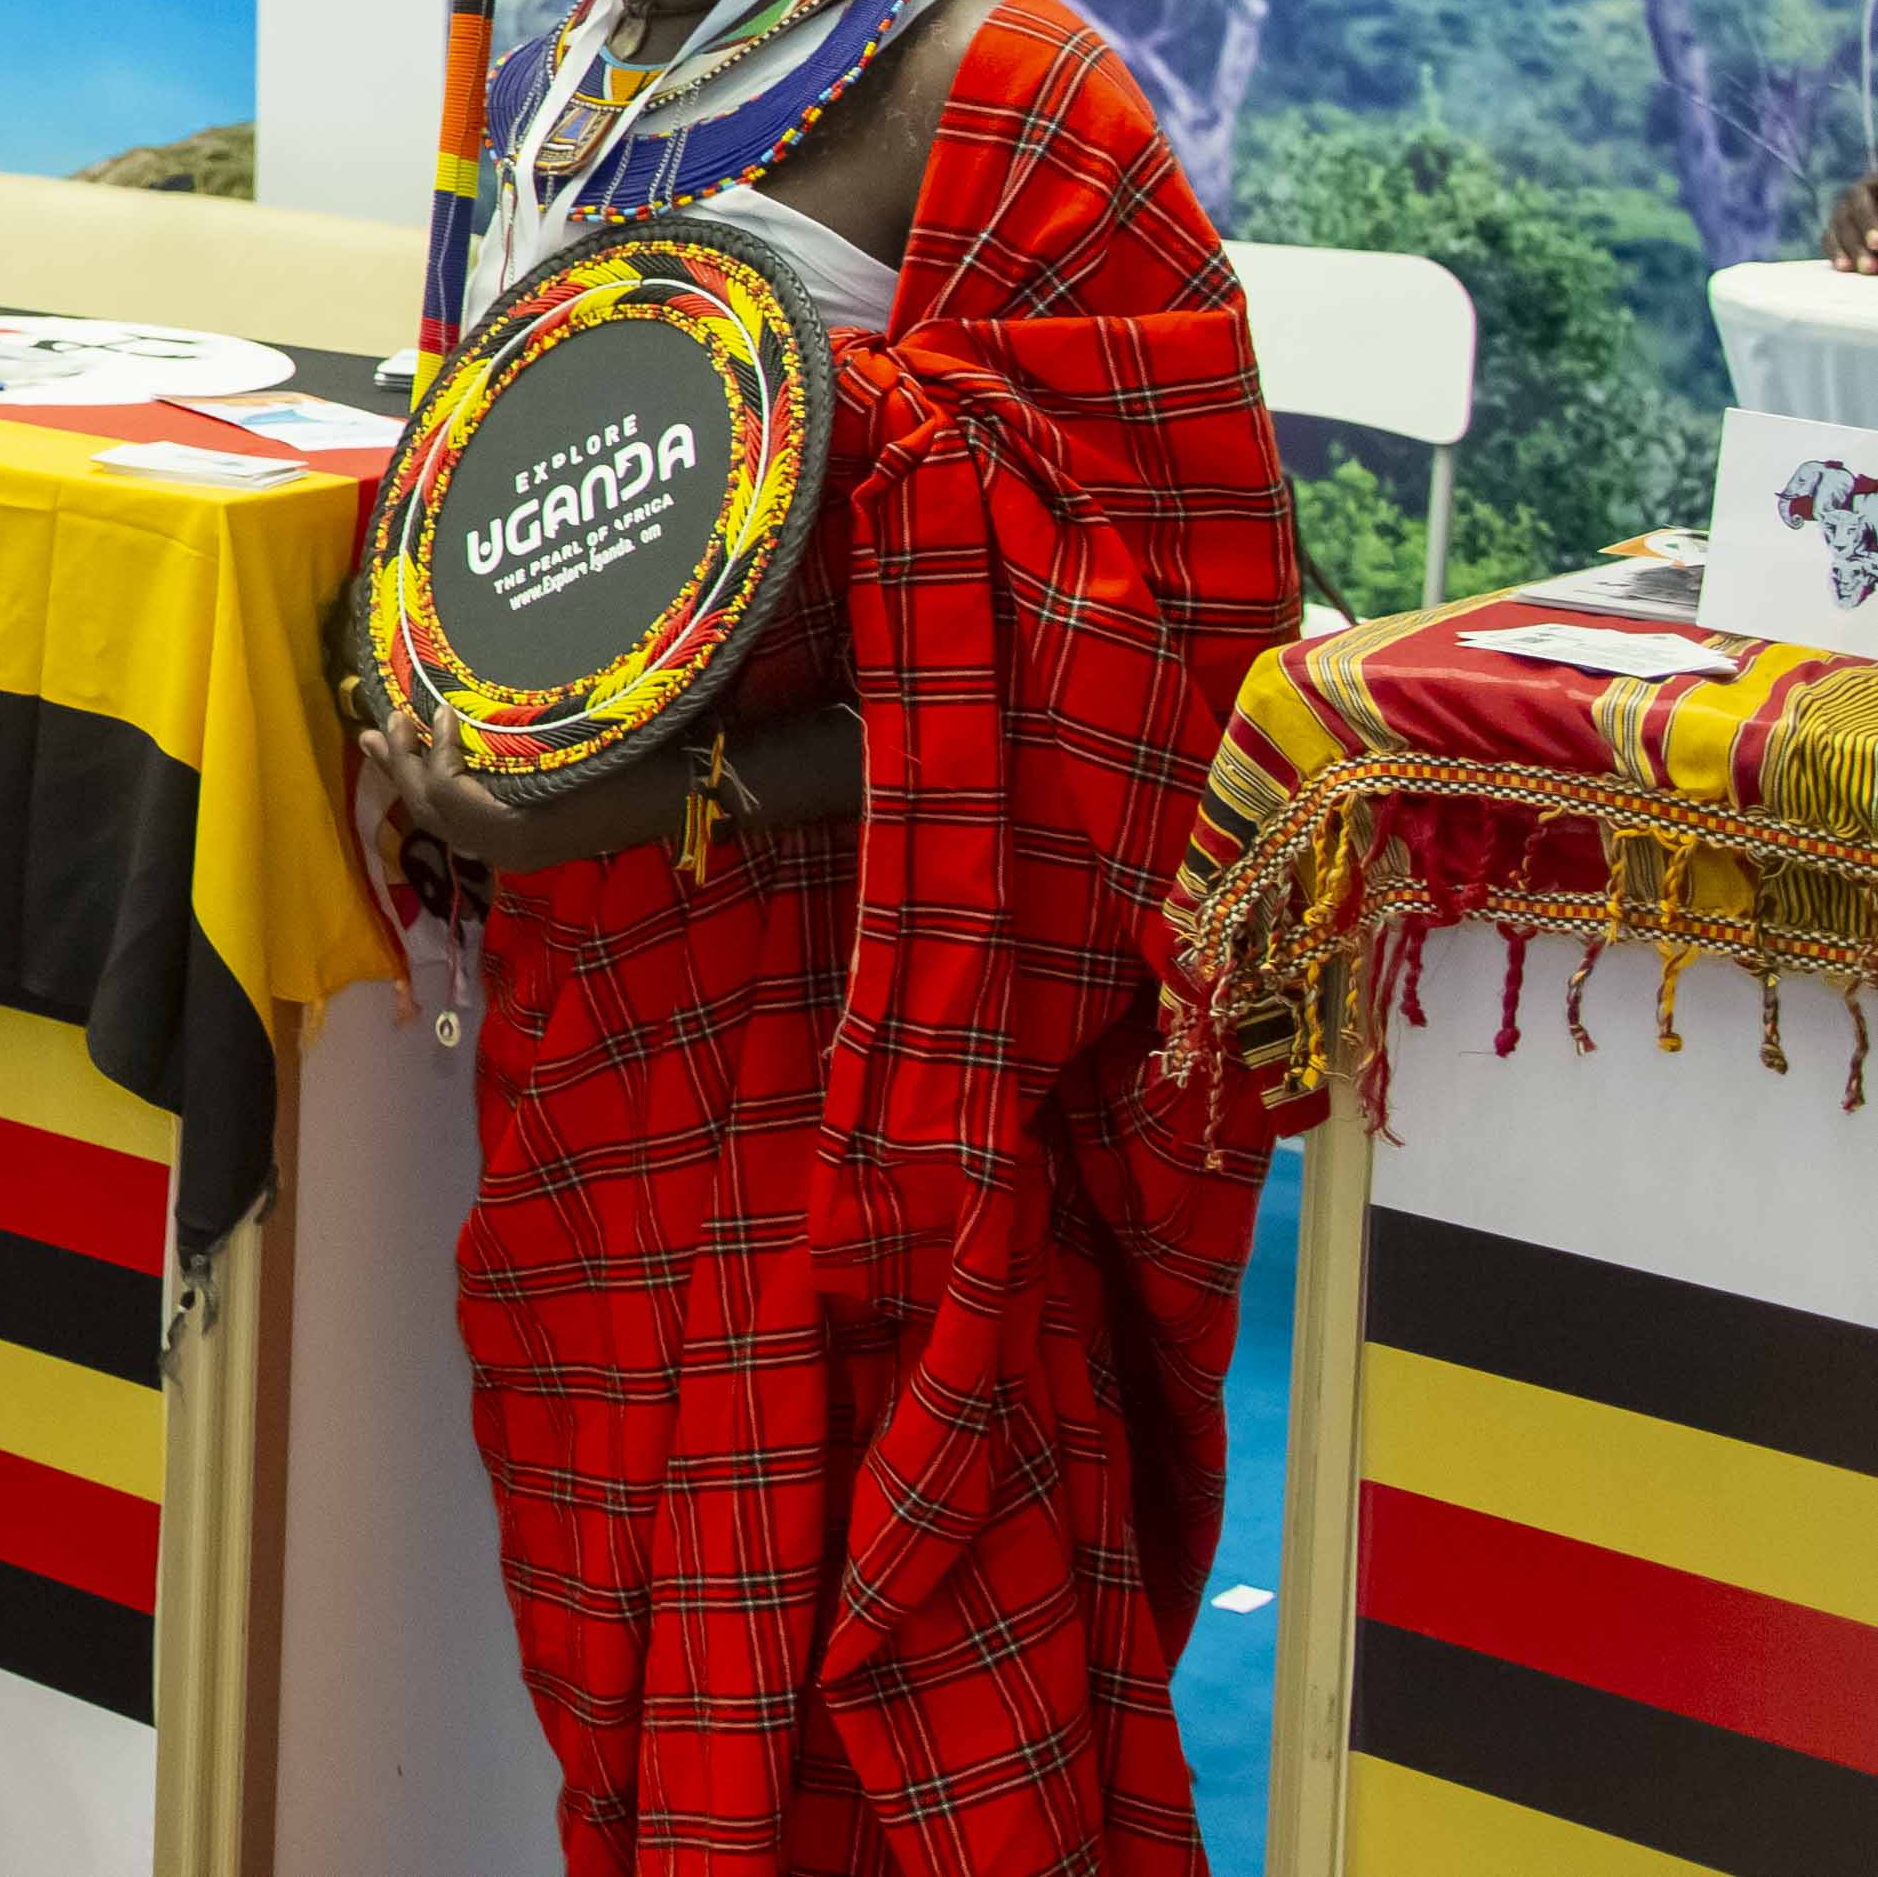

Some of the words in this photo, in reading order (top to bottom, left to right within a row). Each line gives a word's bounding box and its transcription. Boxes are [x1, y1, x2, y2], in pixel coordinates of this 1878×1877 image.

[466, 422, 696, 575] UGANDA
[514, 413, 639, 495] EXPLORE
[493, 567, 527, 595] THE
[529, 540, 584, 577] PEARL
[586, 525, 609, 547] OF
[613, 492, 675, 531] AFRICA
